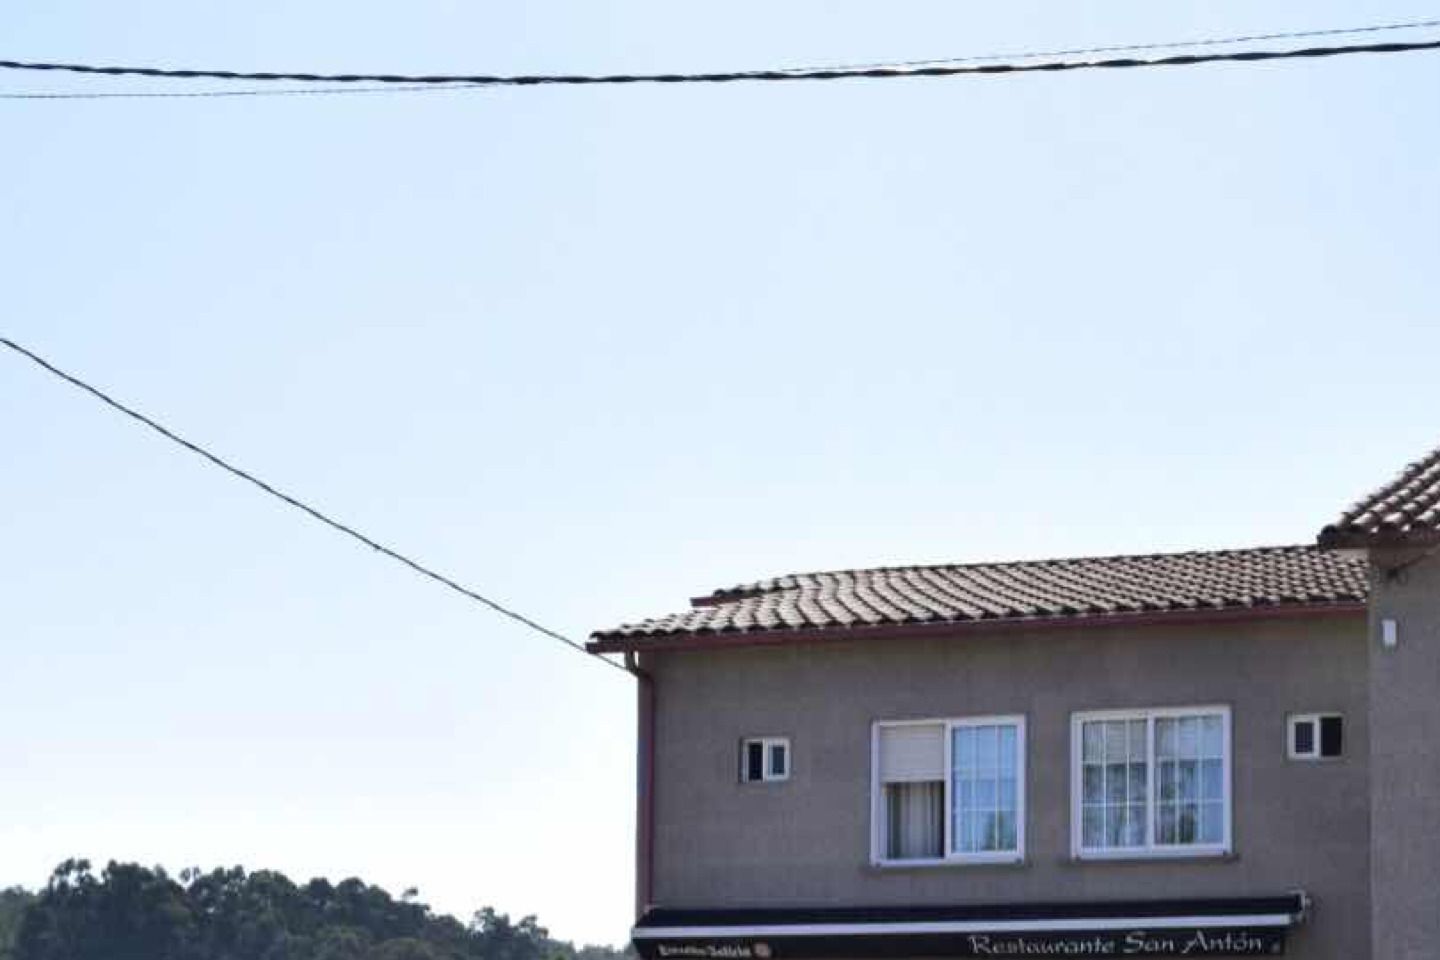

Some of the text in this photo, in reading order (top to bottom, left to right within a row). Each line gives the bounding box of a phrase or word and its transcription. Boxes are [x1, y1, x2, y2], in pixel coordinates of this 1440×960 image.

[968, 929, 1262, 954] Restaurante San Antón
